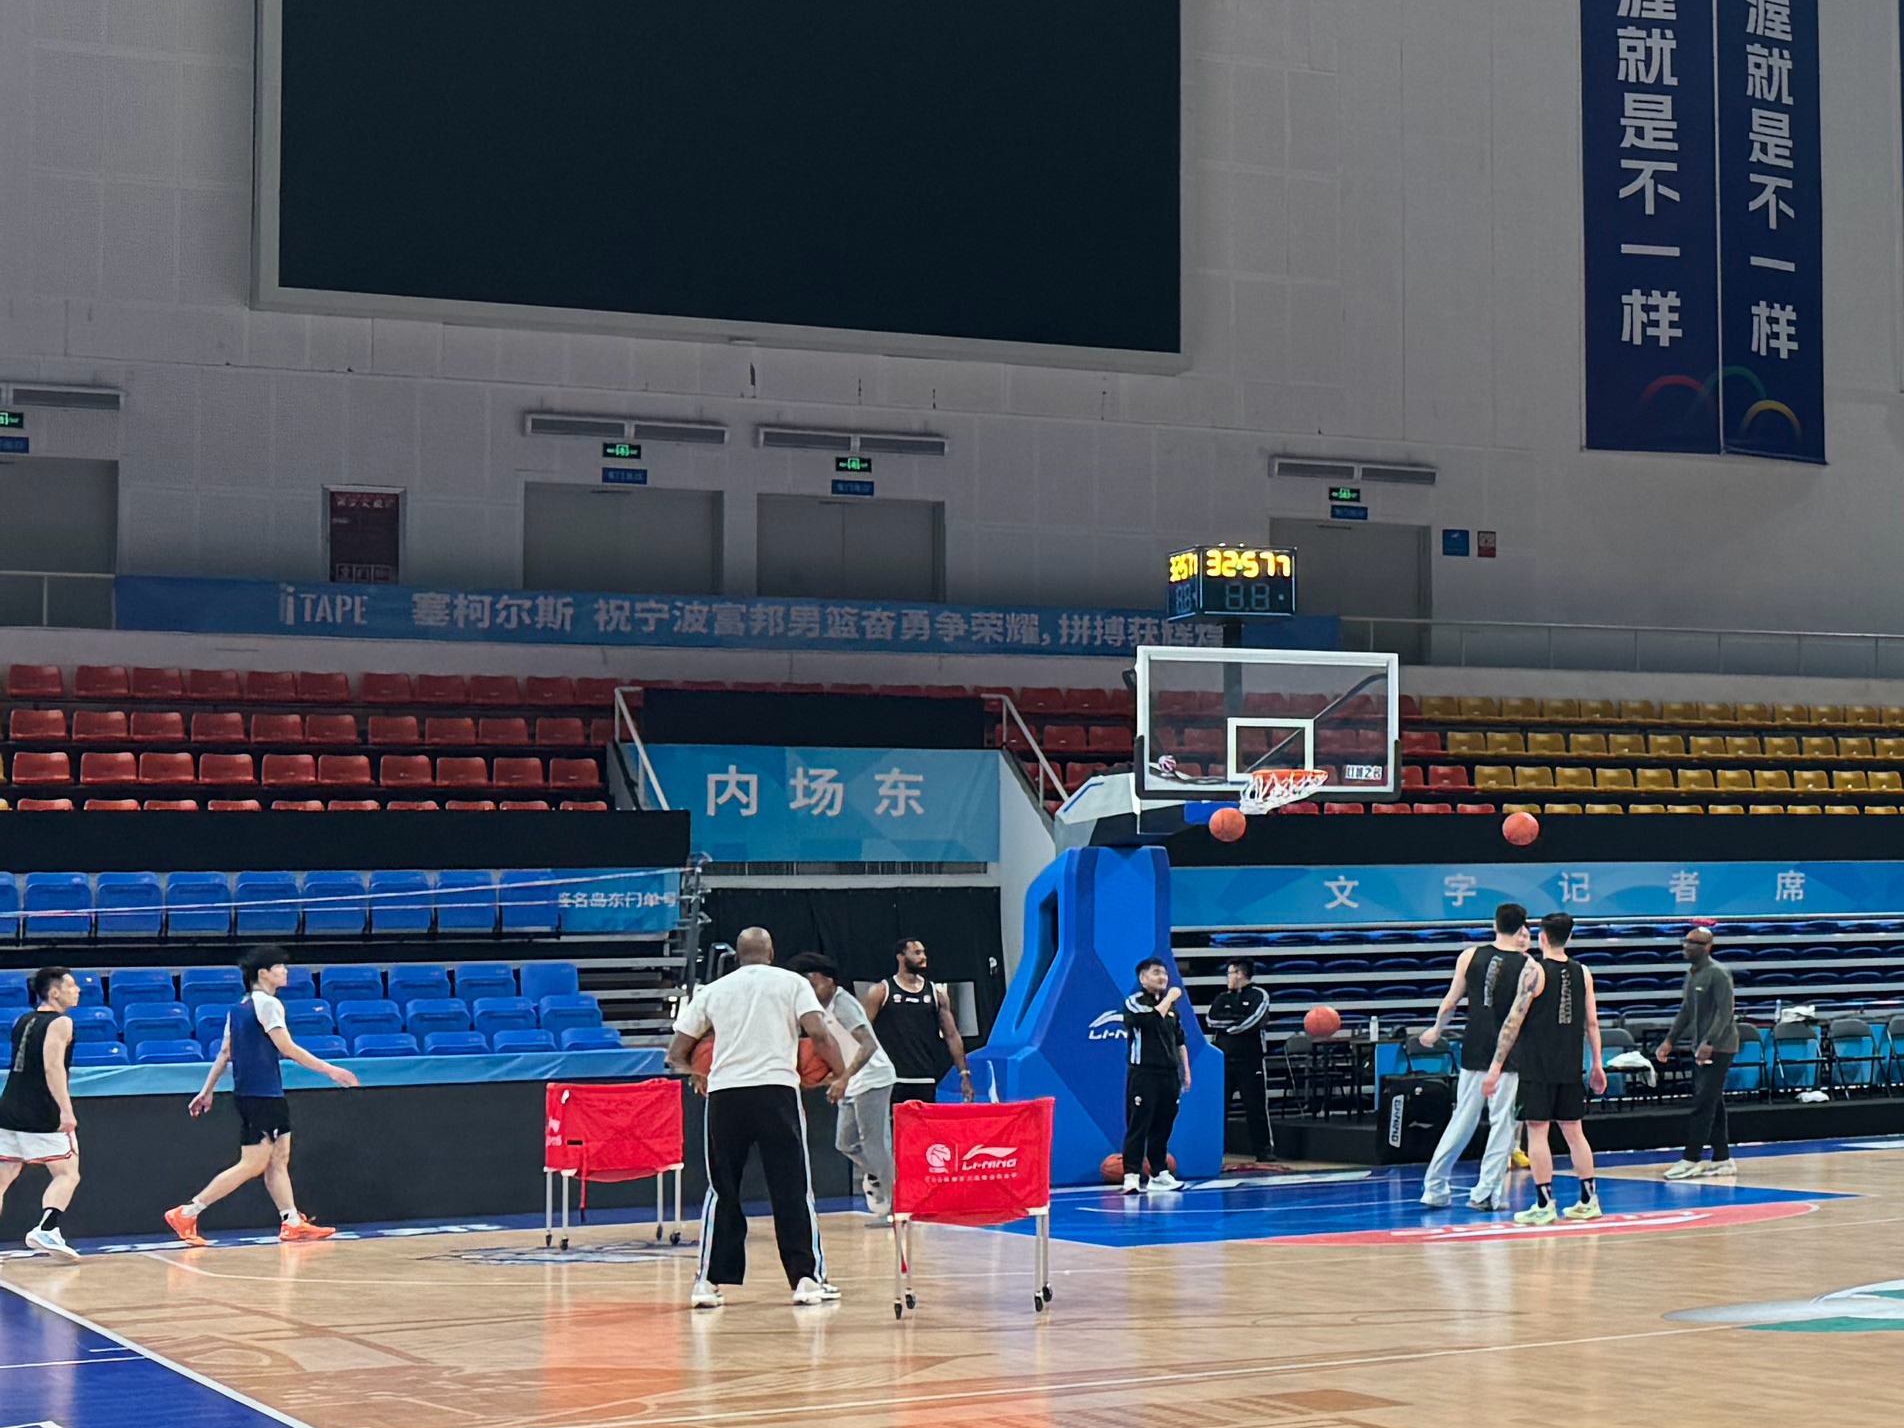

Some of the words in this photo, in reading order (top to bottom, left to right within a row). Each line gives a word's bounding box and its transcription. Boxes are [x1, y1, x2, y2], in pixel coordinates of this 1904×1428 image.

[411, 591, 573, 632] 塞柯尔斯
[706, 766, 924, 818] 内场东
[1325, 869, 1806, 910] 文字记者席
[1088, 1029, 1128, 1040] LI-N
